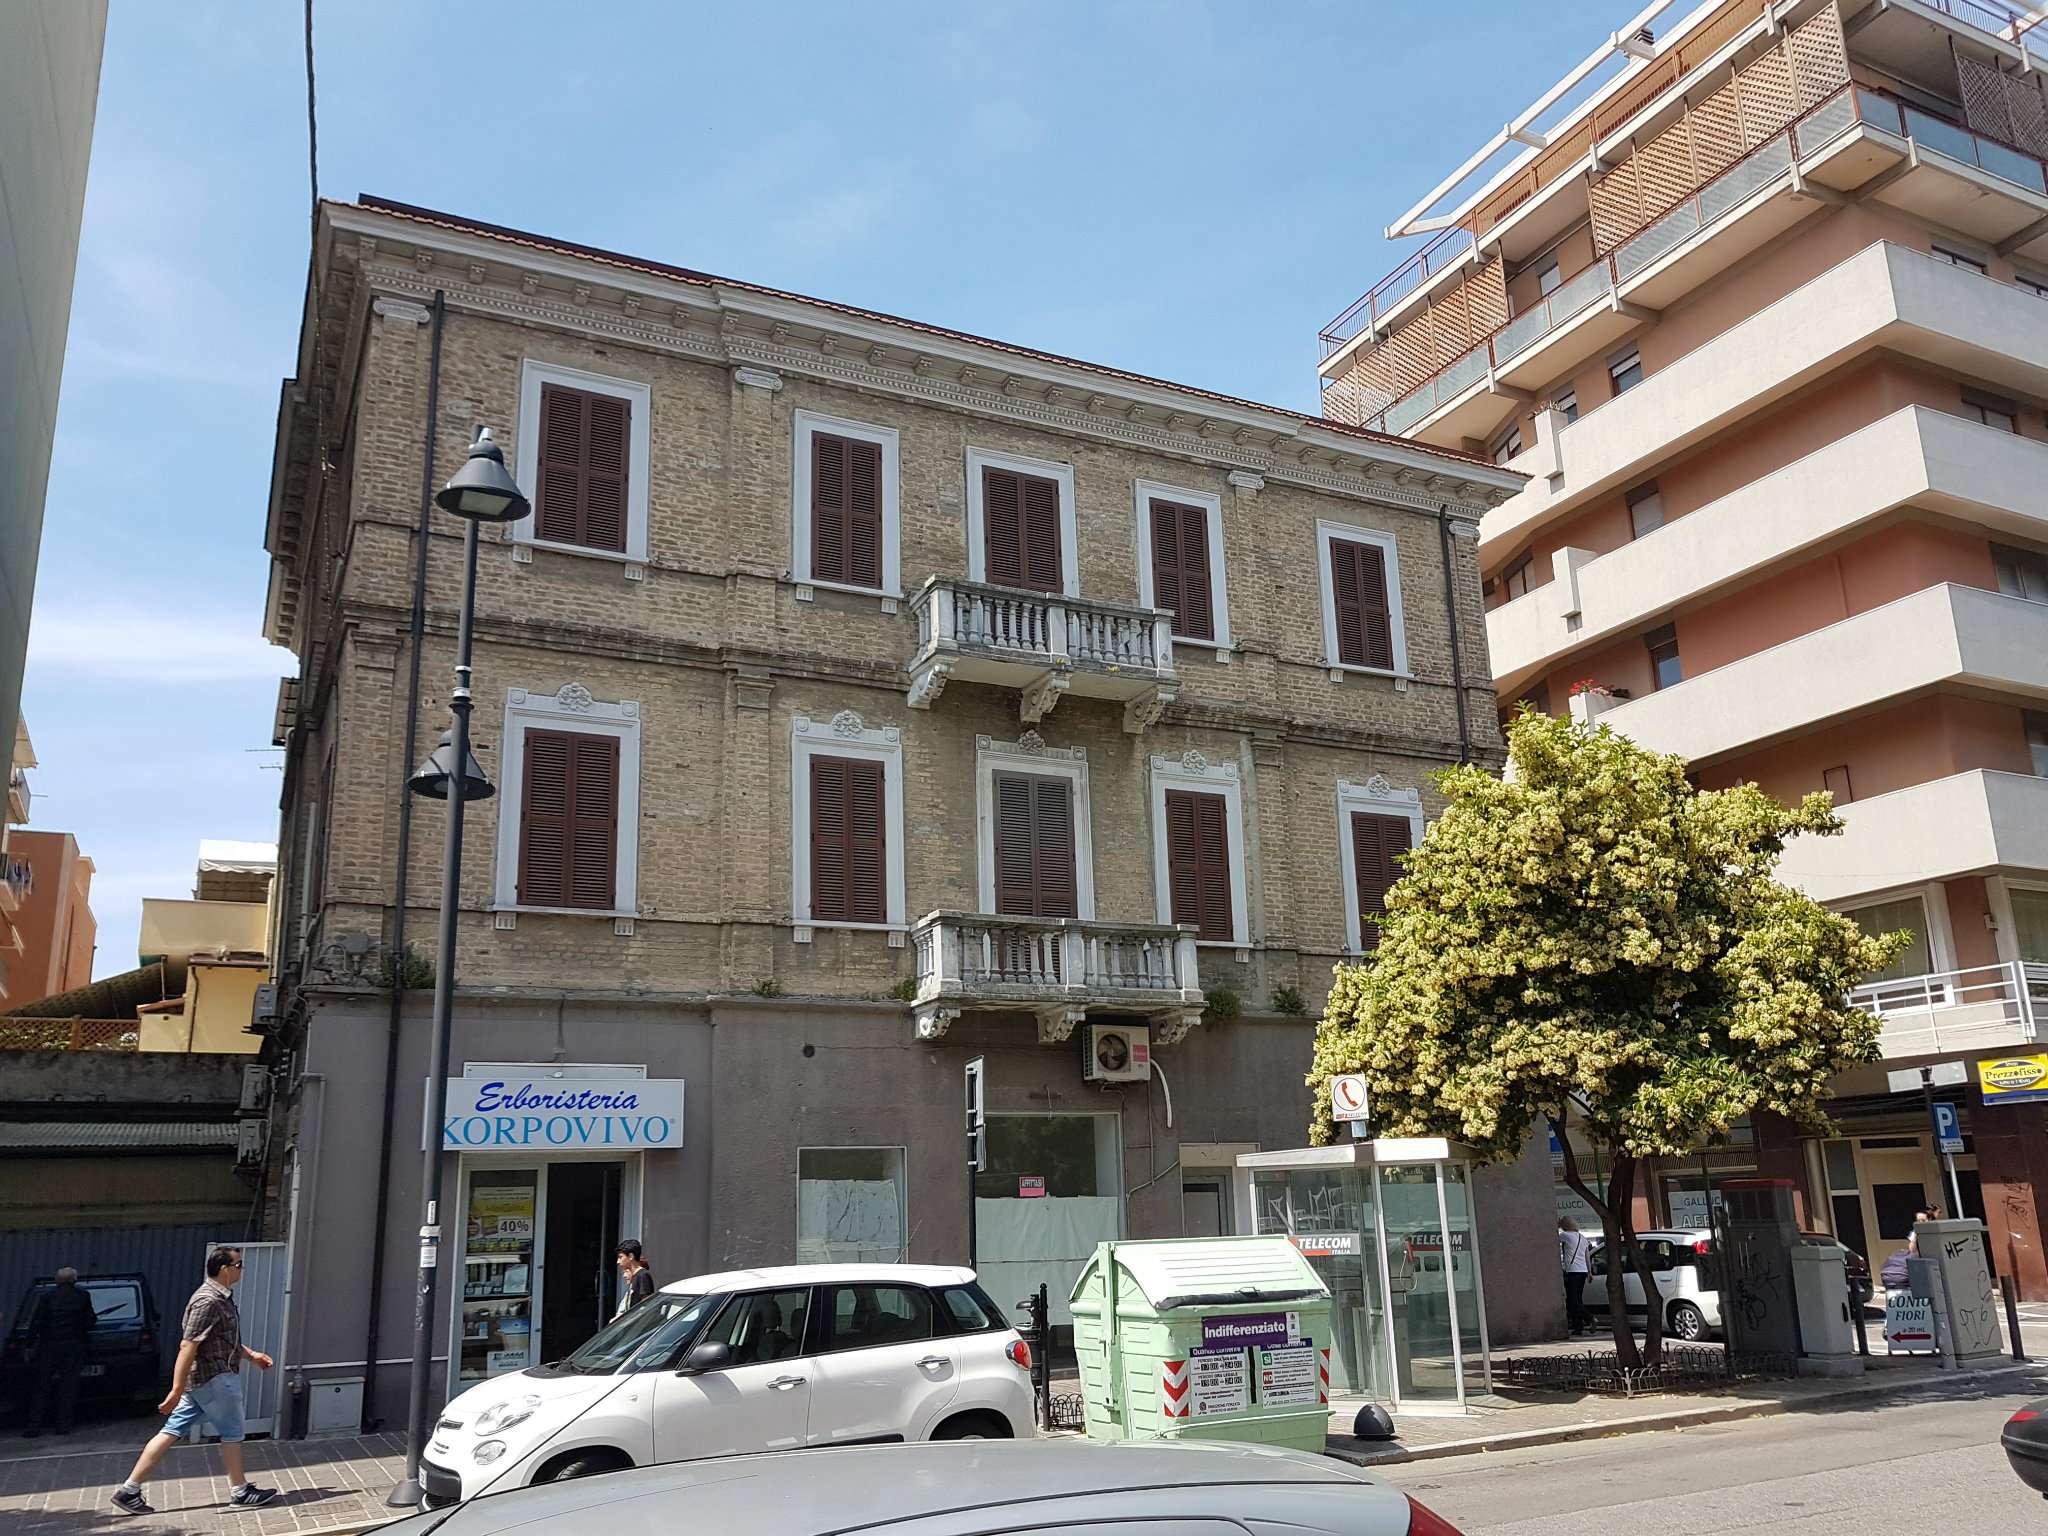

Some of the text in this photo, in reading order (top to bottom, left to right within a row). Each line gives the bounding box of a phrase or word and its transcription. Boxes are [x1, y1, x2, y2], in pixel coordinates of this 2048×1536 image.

[475, 1081, 640, 1112] Erboristeria
[1936, 1106, 1953, 1137] P
[500, 1220, 529, 1233] 40%
[1298, 1237, 1351, 1250] TELECOM
[1409, 1233, 1463, 1246] TELECM
[1895, 1310, 1926, 1321] FIORI
[1204, 1323, 1286, 1339] Indifferenziato
[1263, 1374, 1274, 1384] NO
